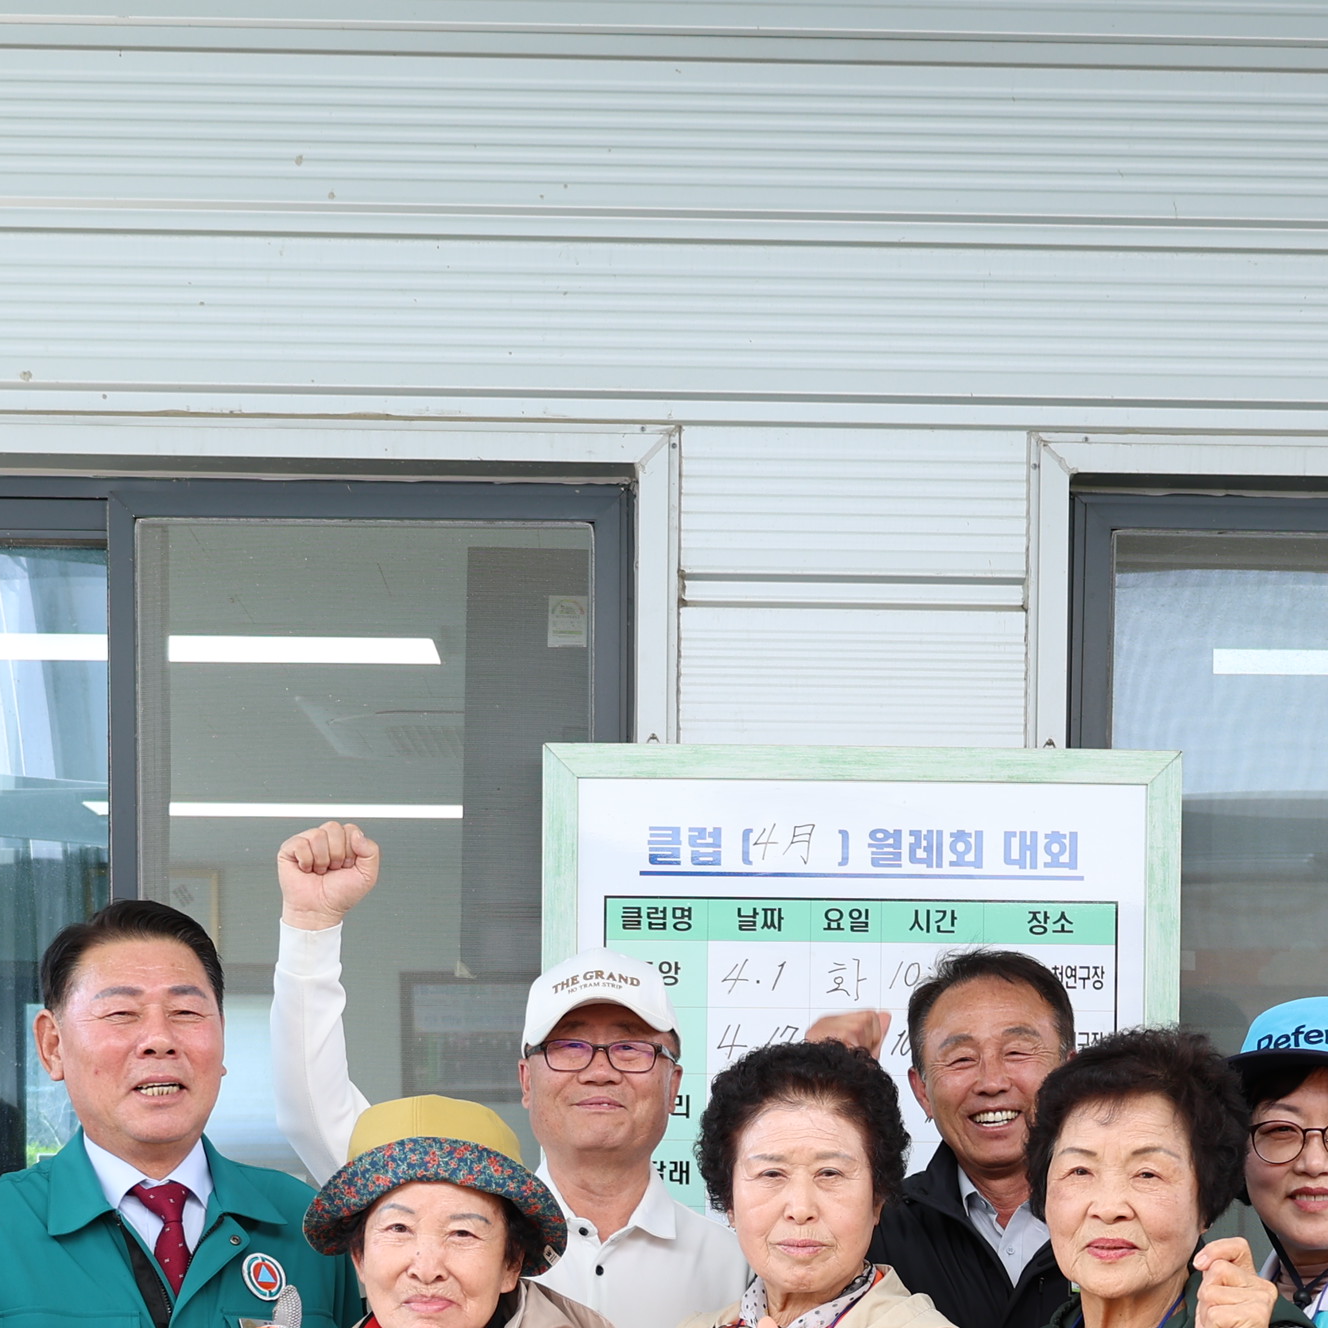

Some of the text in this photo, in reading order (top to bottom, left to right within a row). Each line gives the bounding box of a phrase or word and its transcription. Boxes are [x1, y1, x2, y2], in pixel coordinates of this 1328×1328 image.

[647, 826, 722, 866] 클럽
[867, 828, 984, 869] 월례회
[1003, 830, 1078, 870] 대회
[621, 906, 1074, 936] 클럽명 날짜 요일 시간 장소
[552, 969, 641, 994] THE GRAND
[646, 960, 681, 986] 앙
[826, 957, 867, 1001] 화
